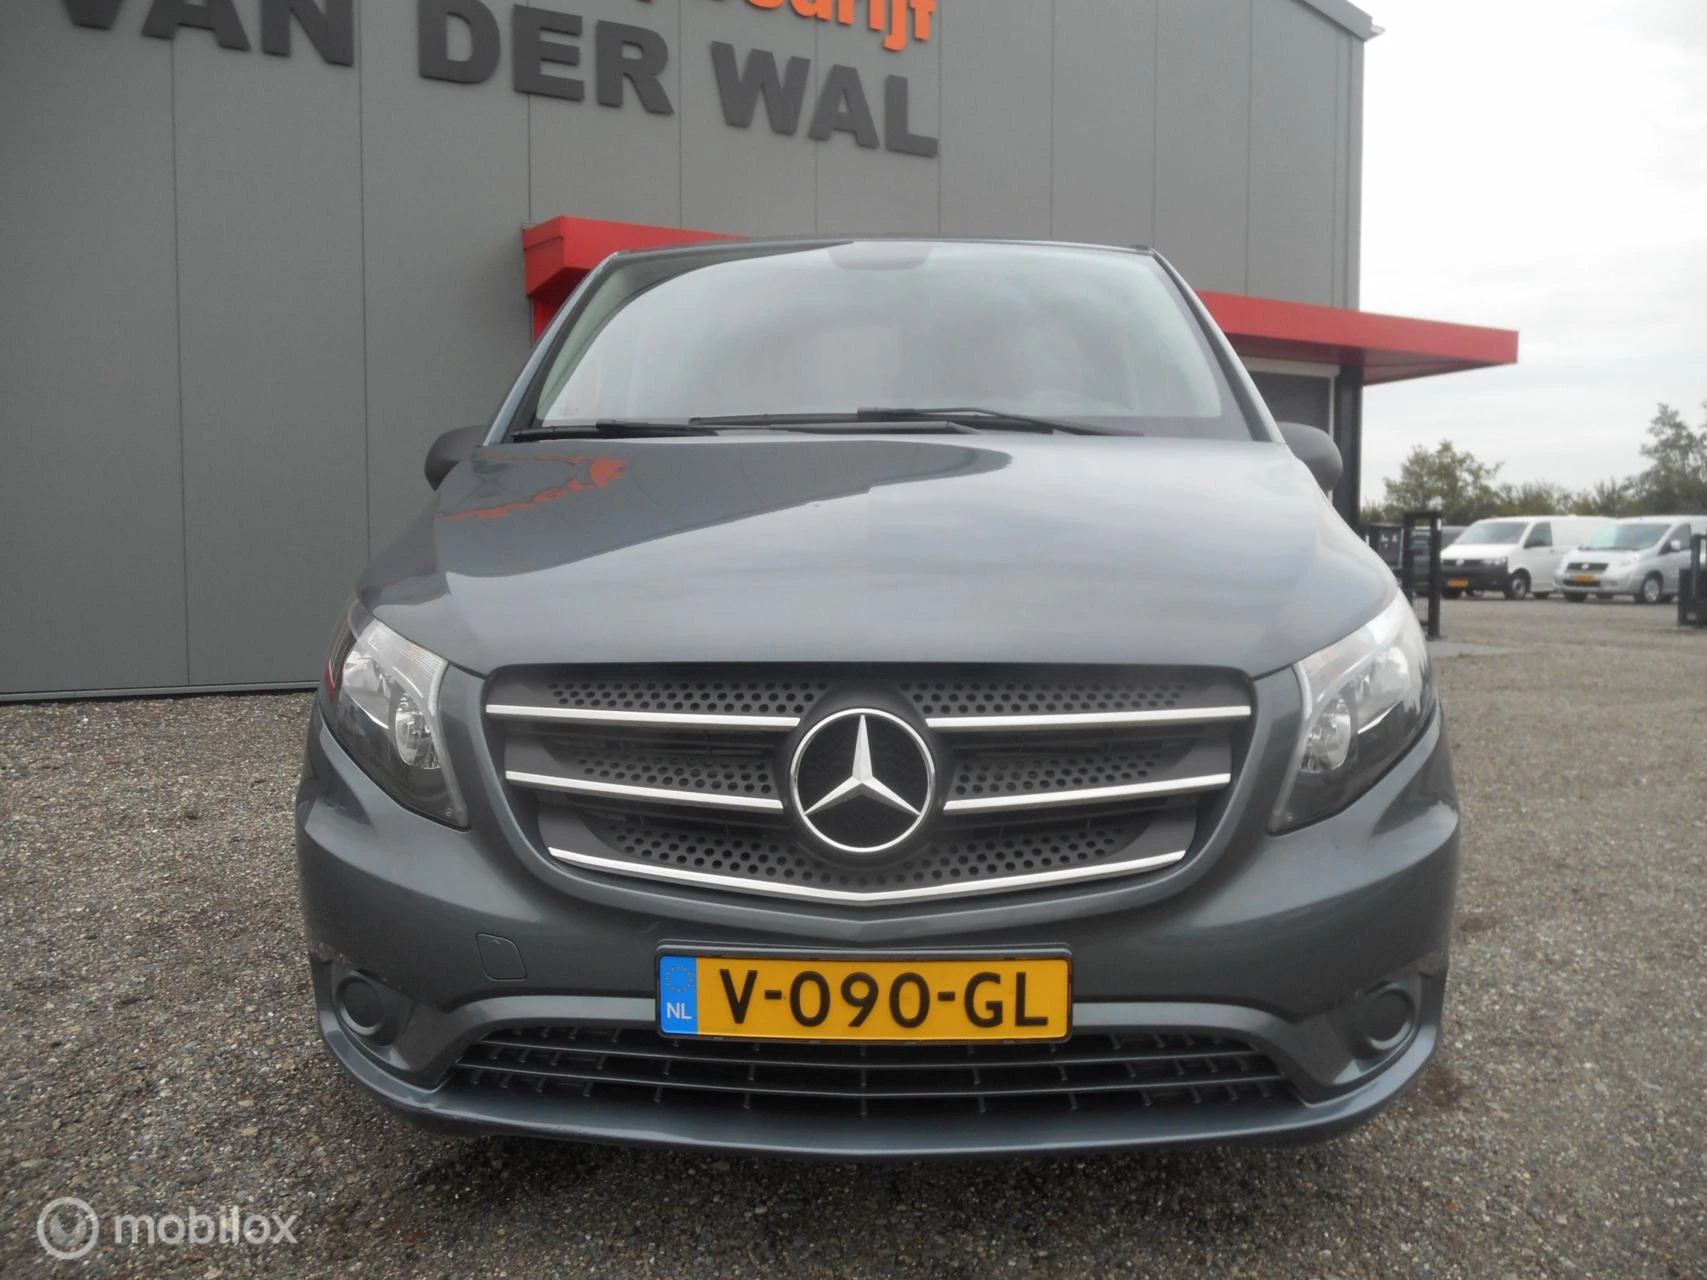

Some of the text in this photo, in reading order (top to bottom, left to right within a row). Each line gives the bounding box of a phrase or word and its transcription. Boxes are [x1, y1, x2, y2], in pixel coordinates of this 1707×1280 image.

[416, 0, 674, 116] DER
[711, 41, 938, 158] WAL
[666, 968, 1049, 1029] NL V-090-GL
